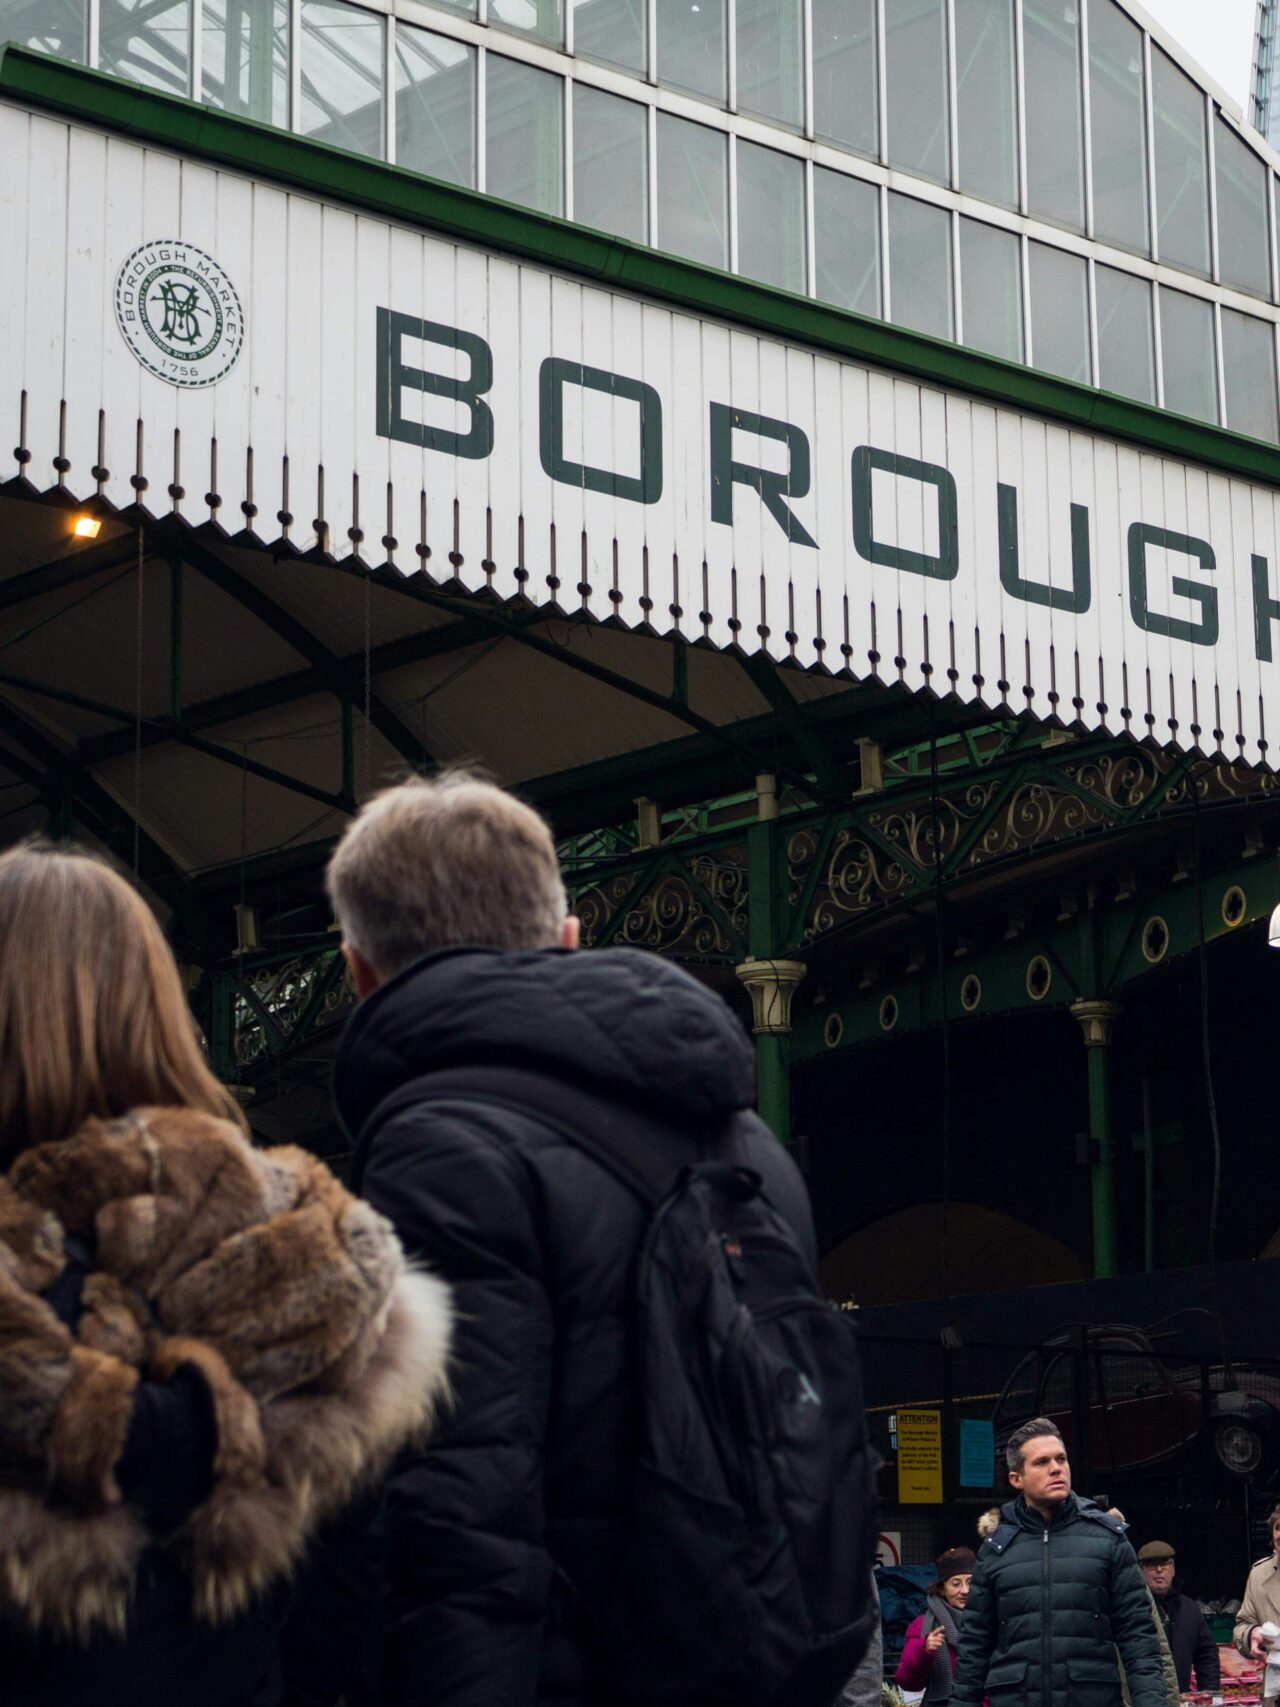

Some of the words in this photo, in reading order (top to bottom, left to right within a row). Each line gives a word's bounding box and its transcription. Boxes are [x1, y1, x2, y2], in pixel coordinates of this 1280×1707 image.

[124, 250, 186, 321] BOROUGH
[197, 261, 236, 348] MARKET
[161, 359, 199, 376] 1756
[900, 1415, 938, 1423] ATTENTION
